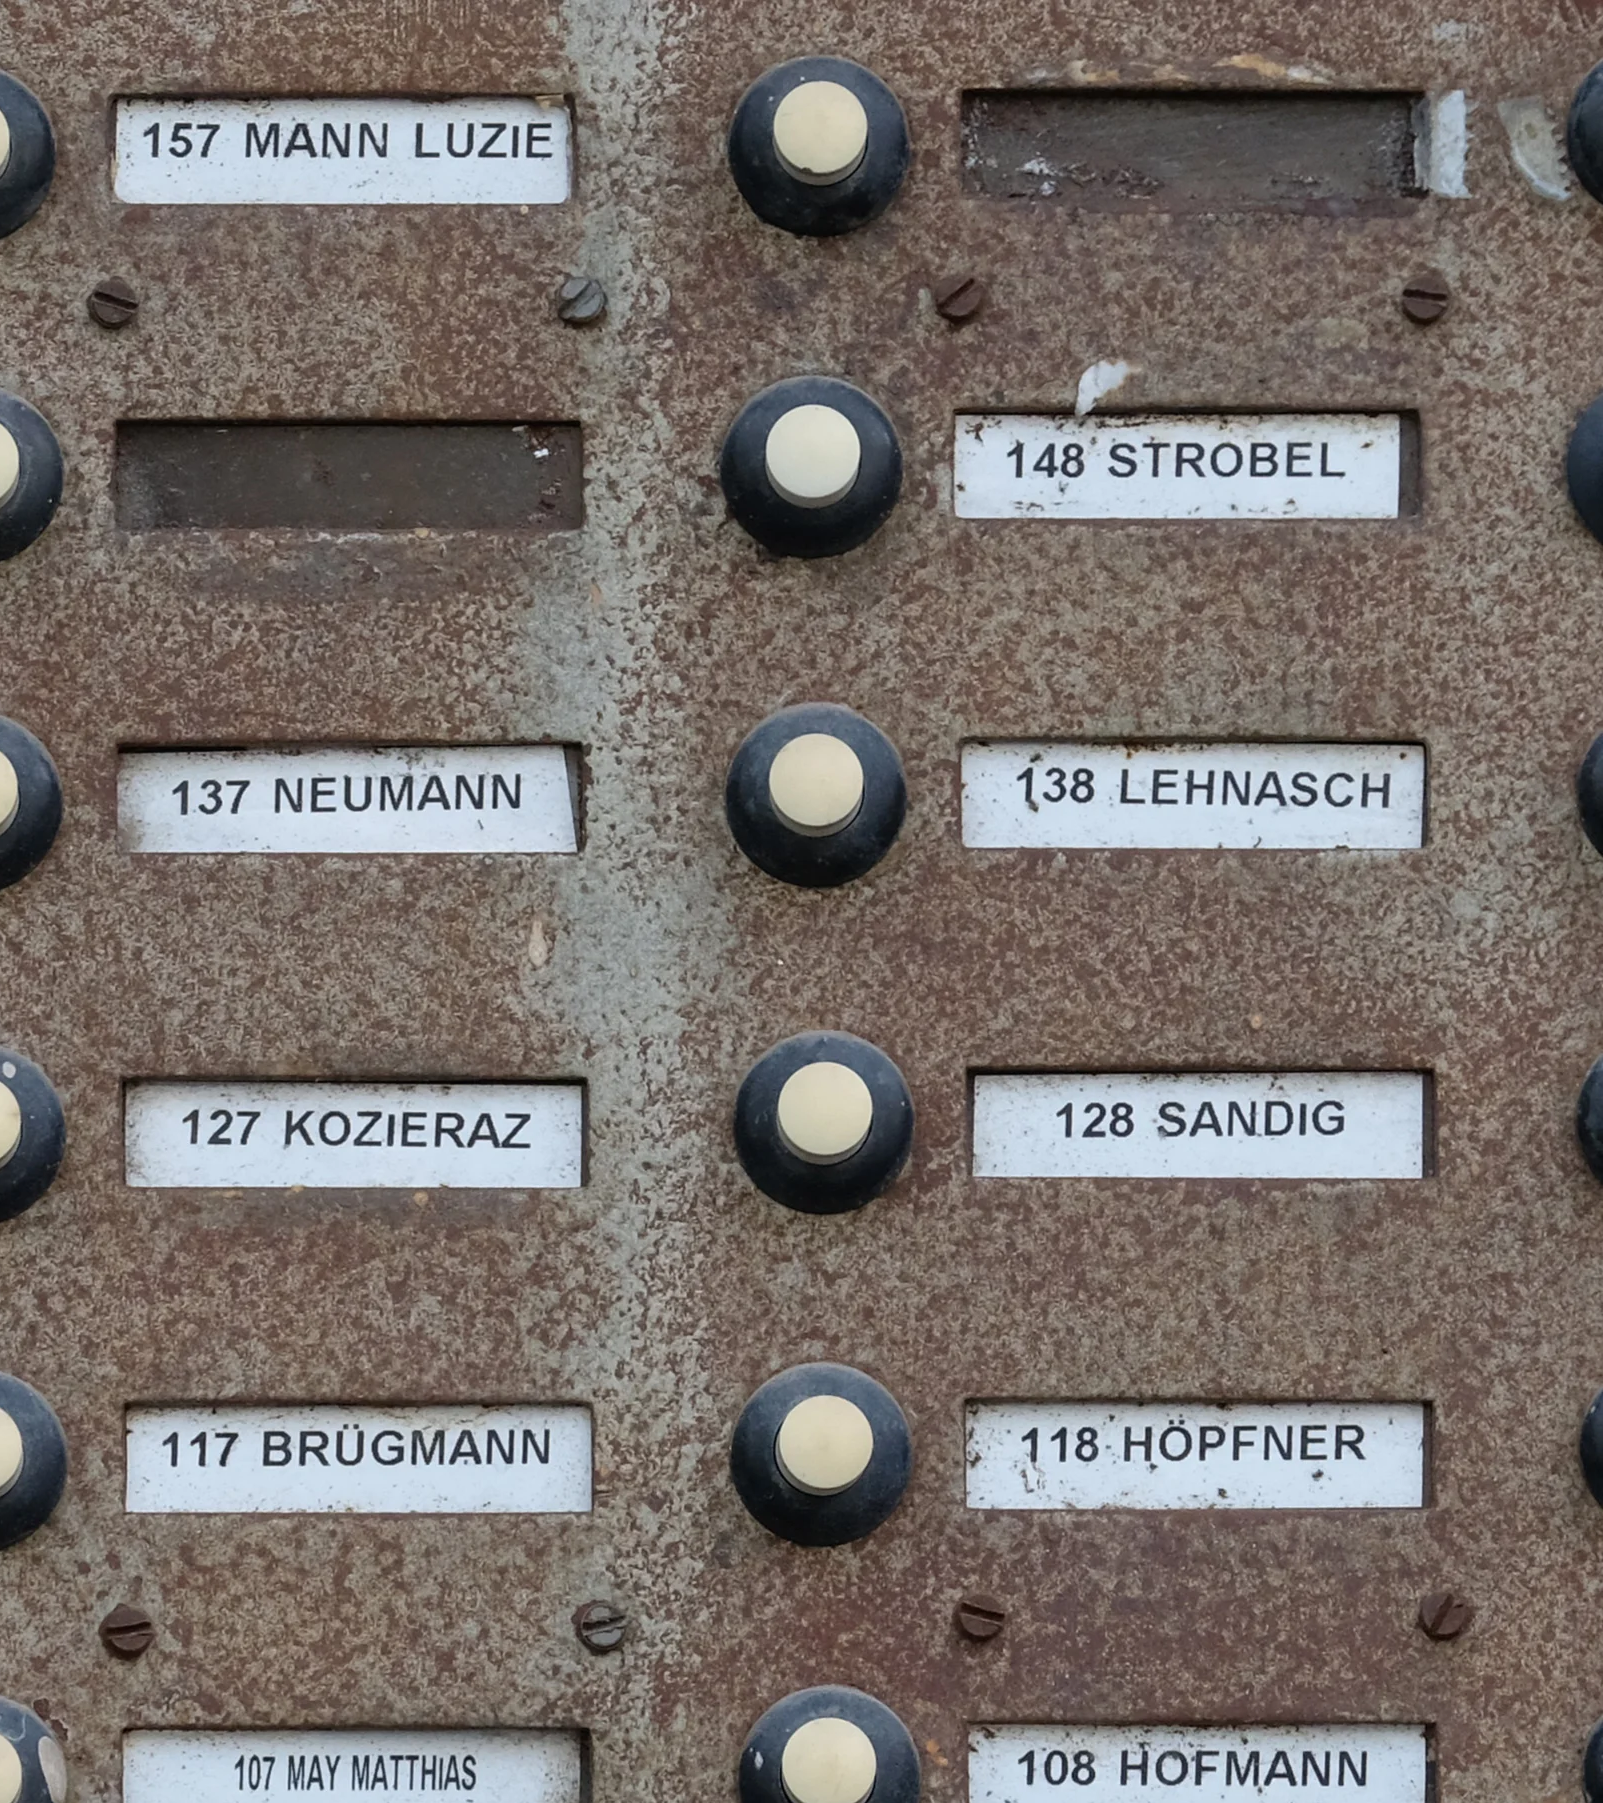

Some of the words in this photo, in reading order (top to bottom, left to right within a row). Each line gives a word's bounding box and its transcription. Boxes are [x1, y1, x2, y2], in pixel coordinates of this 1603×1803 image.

[143, 122, 221, 158] 157
[245, 122, 389, 159] MANN
[414, 122, 553, 159] LUZIE
[1006, 439, 1085, 479] 148
[1107, 436, 1346, 478] STROBEL
[172, 779, 251, 816] 137
[274, 773, 522, 814] NEUMANN
[1016, 766, 1095, 813] 138
[1119, 768, 1391, 809] LEHNASCH
[182, 1108, 261, 1146] 127
[284, 1110, 531, 1149] KOZIERAZ
[1056, 1102, 1135, 1138] 128
[1156, 1100, 1345, 1138] SANDIG
[162, 1431, 240, 1468] 117
[262, 1419, 551, 1467] BRÜGMANN
[1021, 1426, 1099, 1464] 118
[1123, 1419, 1366, 1462] HÖPFNER
[234, 1754, 276, 1791] 107
[287, 1754, 341, 1791] MAY
[351, 1754, 477, 1791] MATTHIAS
[1017, 1749, 1096, 1786] 108
[1119, 1748, 1369, 1789] HOFMANN
